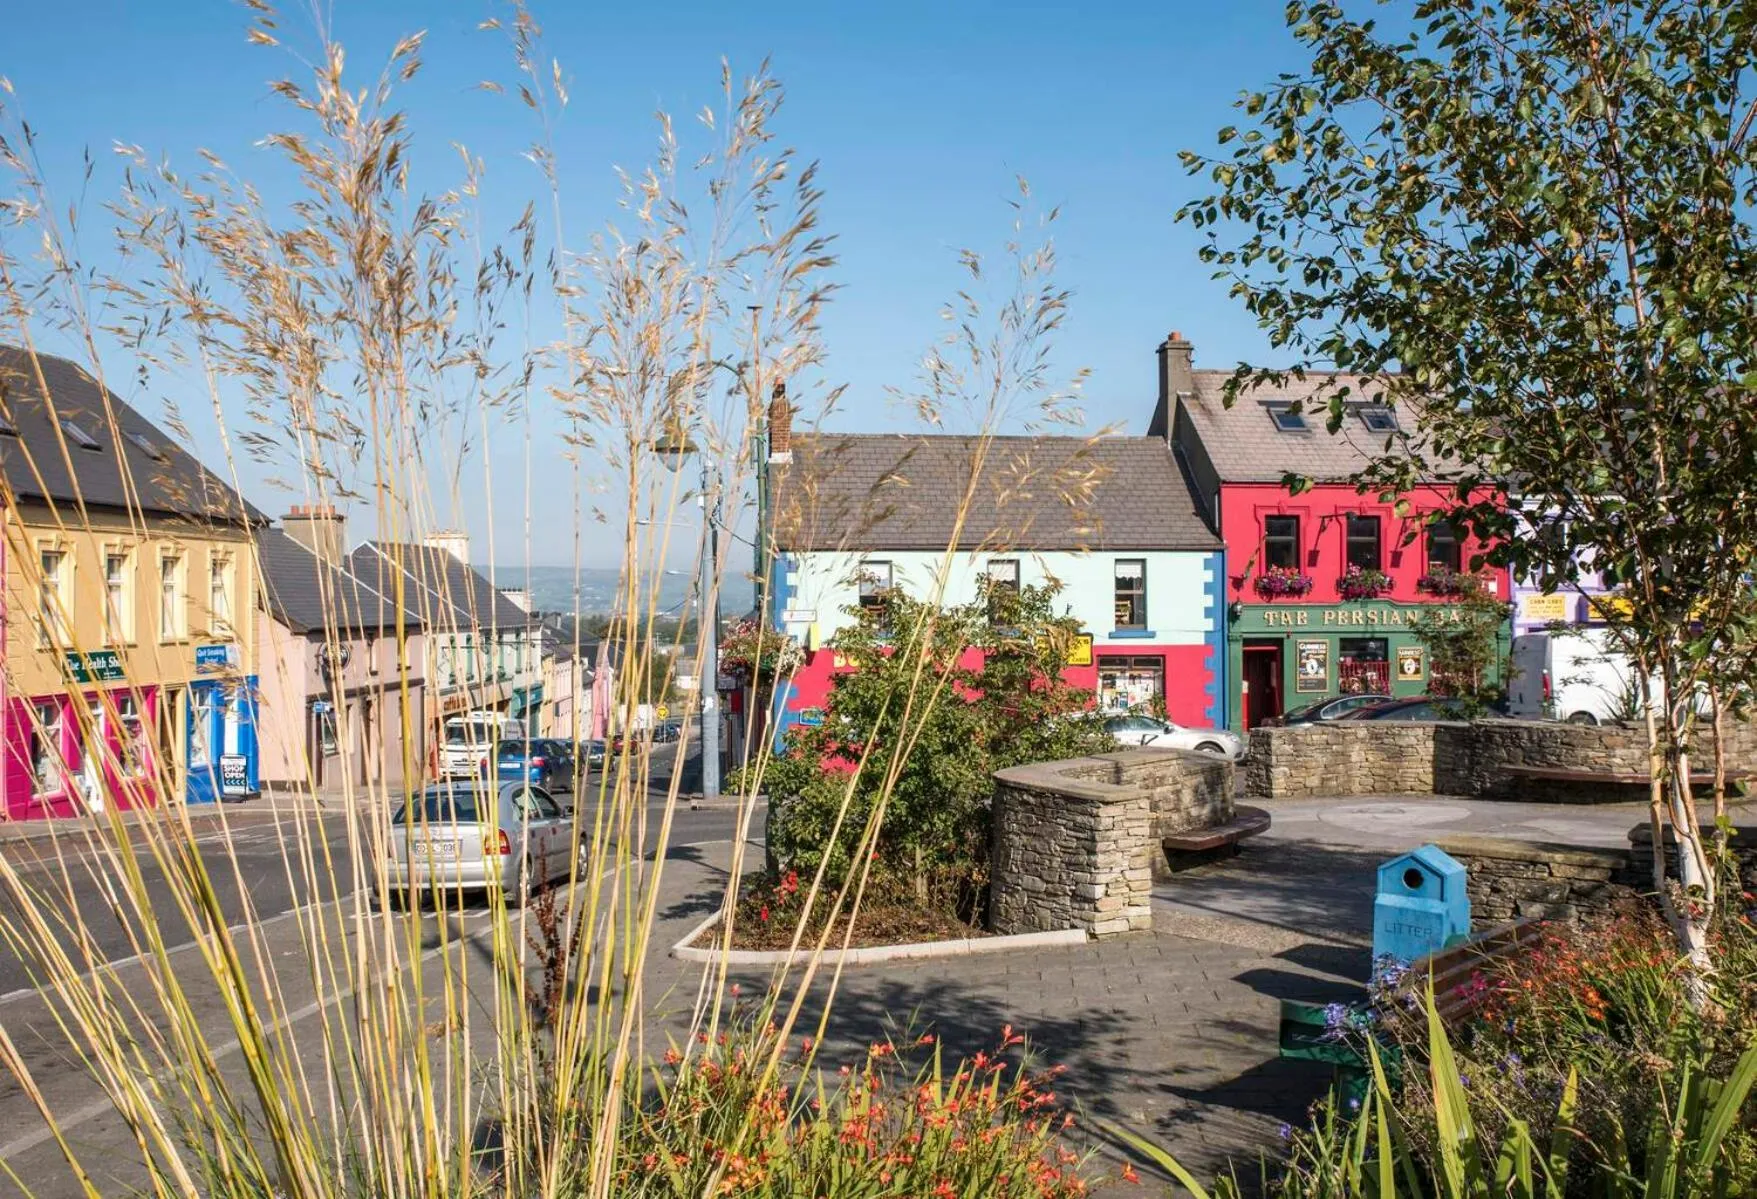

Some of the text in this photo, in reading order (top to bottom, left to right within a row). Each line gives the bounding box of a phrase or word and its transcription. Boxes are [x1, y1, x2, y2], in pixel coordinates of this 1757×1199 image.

[1263, 609, 1308, 626] THE
[1323, 609, 1419, 626] PERSIAN
[223, 764, 247, 772] SHOP
[223, 771, 246, 780] OPEN
[1383, 919, 1433, 938] LITTER
